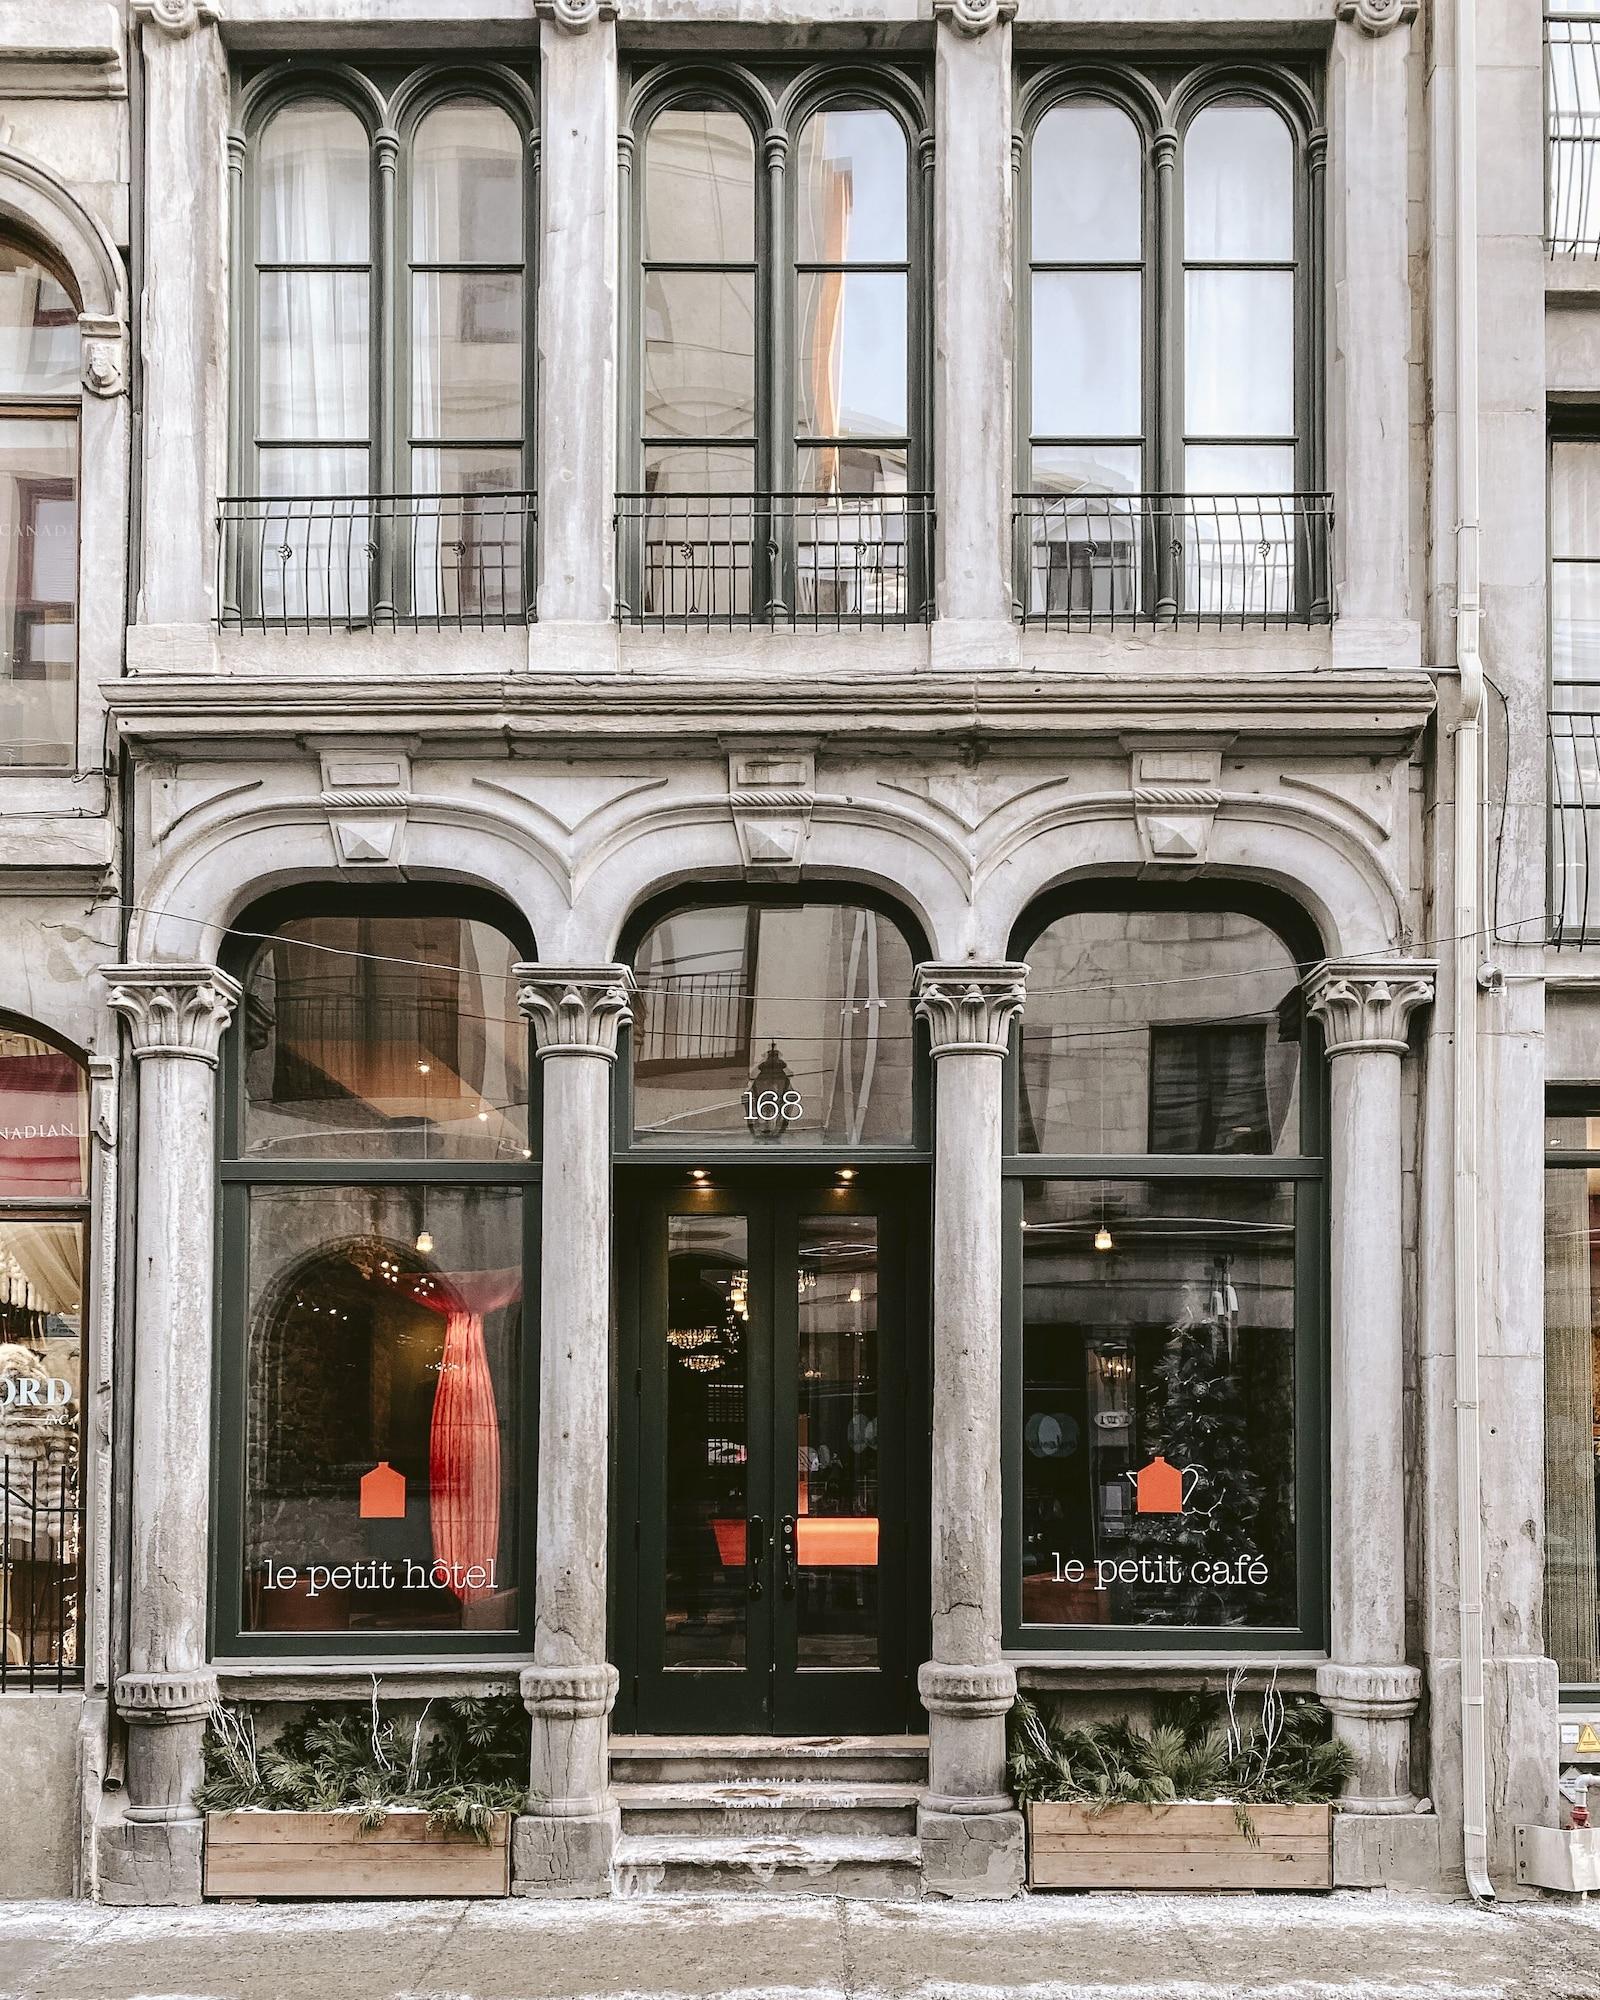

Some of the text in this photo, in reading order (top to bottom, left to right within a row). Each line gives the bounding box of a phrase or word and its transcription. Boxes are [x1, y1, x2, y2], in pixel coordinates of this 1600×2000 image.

[743, 1090, 803, 1120] 168
[263, 1558, 498, 1597] le petit hôtel
[1051, 1552, 1269, 1590] le petit café
